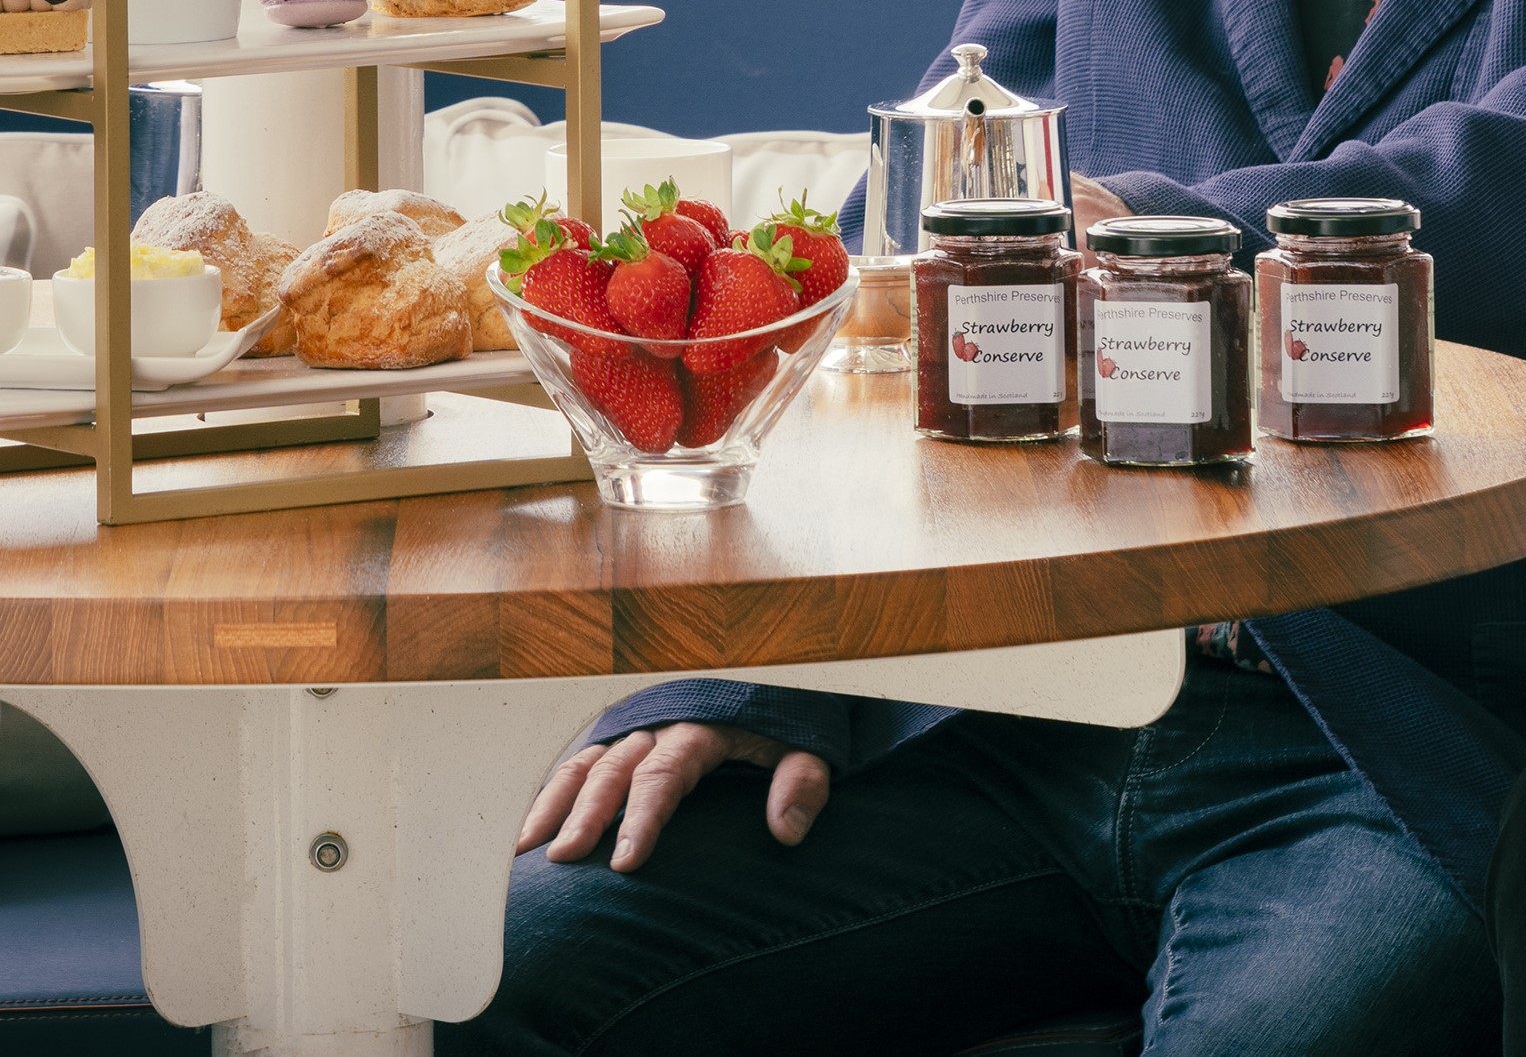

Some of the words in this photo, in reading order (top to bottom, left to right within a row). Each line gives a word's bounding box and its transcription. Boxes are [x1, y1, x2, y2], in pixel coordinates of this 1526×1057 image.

[955, 291, 1008, 305] Perthshire
[1011, 290, 1062, 304] Preserves
[1285, 290, 1336, 304] Perthshire
[1340, 289, 1393, 304] Preserves
[1149, 307, 1203, 322] Preserves
[961, 319, 1054, 336] Strawberry
[1290, 318, 1382, 337] Strawberry
[1099, 336, 1191, 356] Strawberry
[972, 350, 1044, 364] Conserve
[1299, 348, 1372, 362] Conserve
[1109, 366, 1181, 381] Conserve
